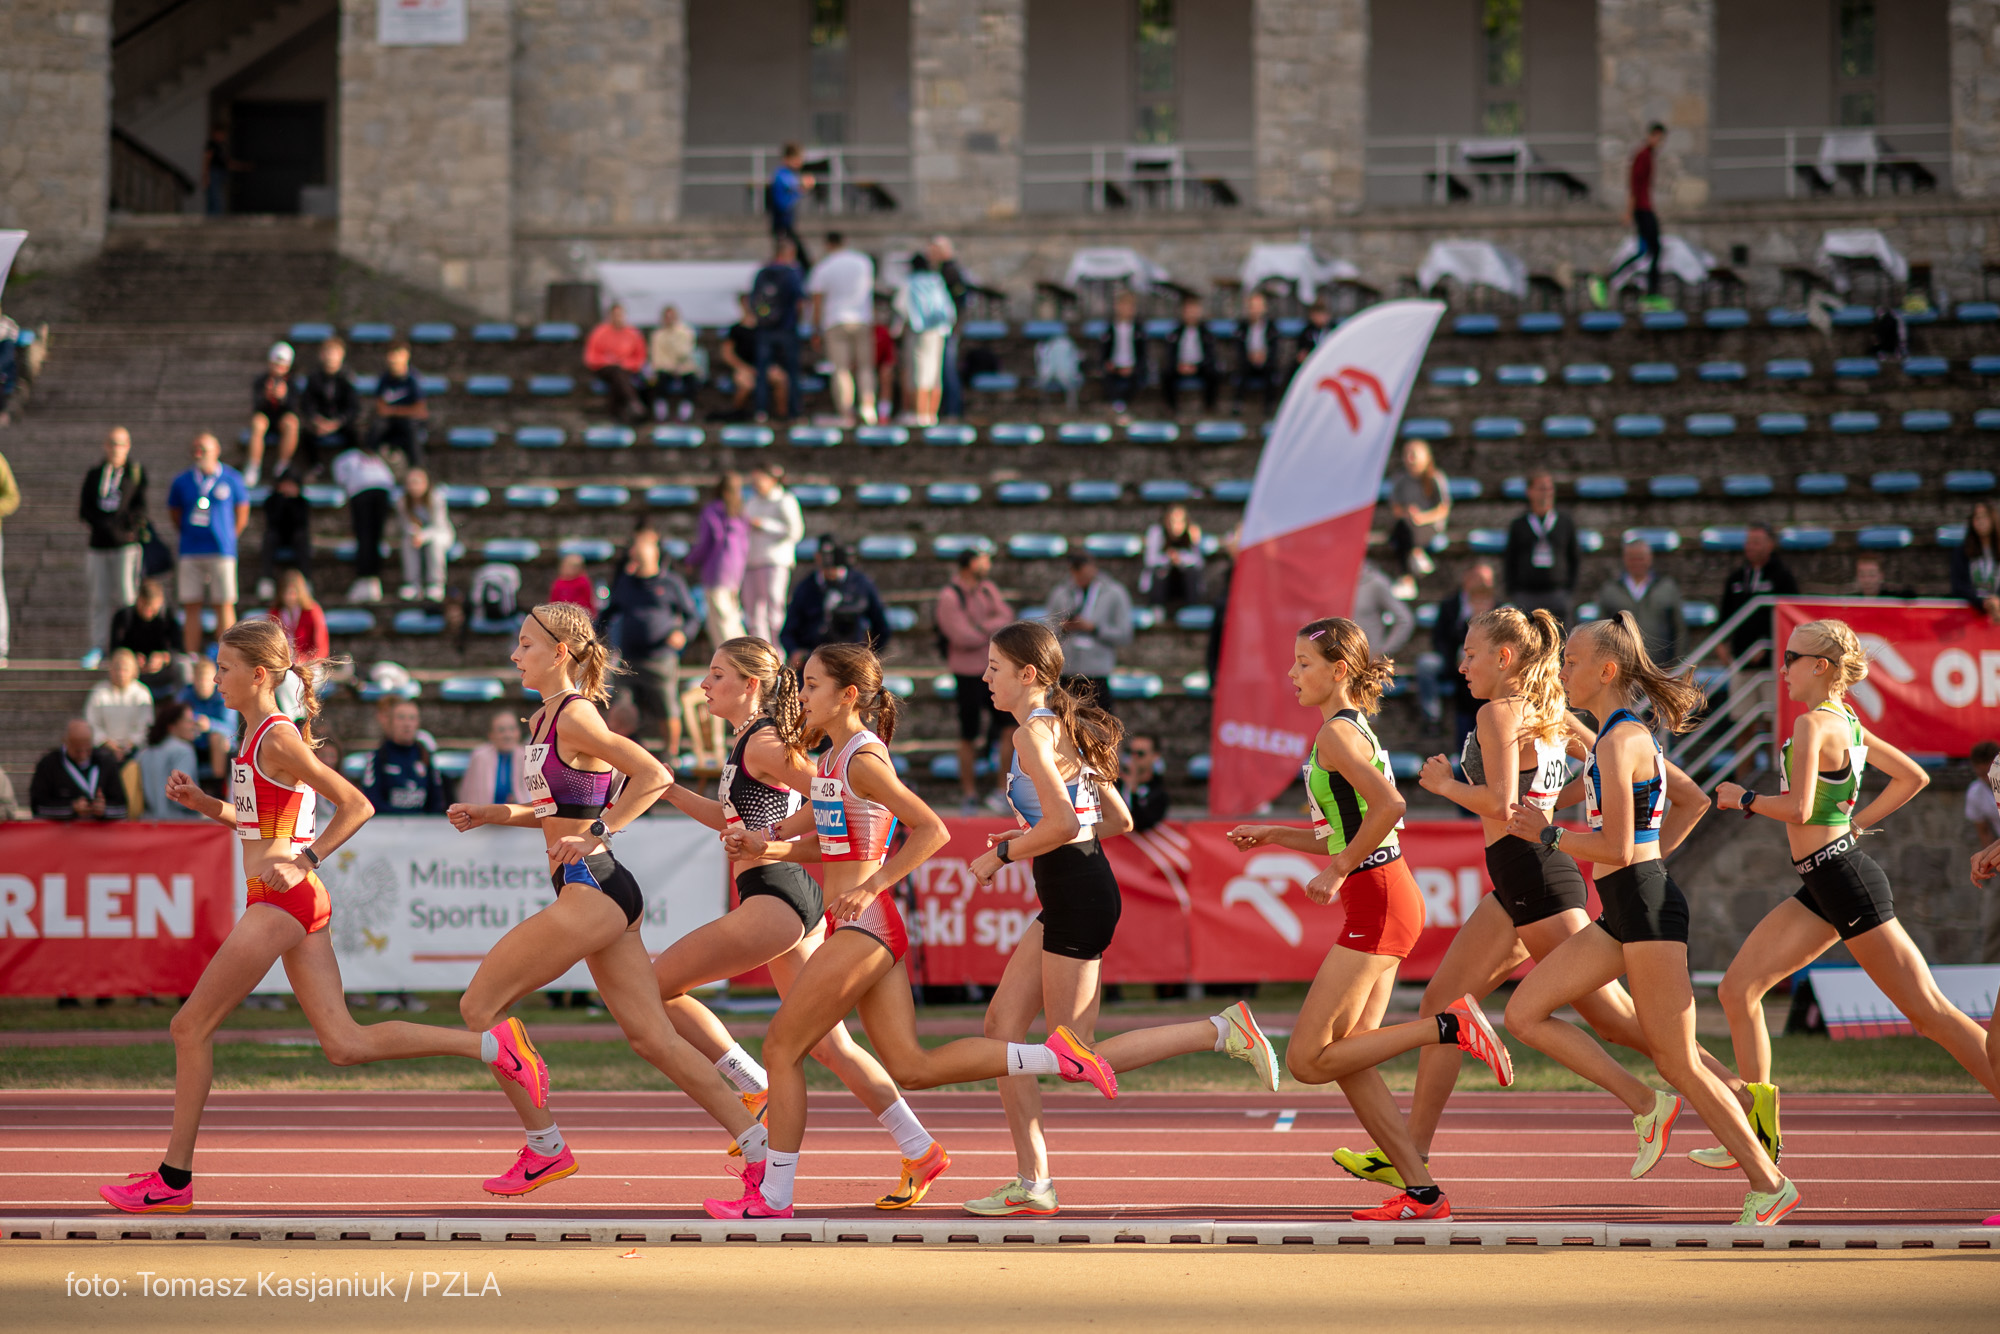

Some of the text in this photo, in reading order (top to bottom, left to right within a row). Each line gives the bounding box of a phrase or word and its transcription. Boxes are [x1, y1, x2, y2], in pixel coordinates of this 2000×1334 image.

[1544, 759, 1562, 789] 692
[1815, 839, 1848, 866] PRO
[409, 900, 508, 933] Sportu
